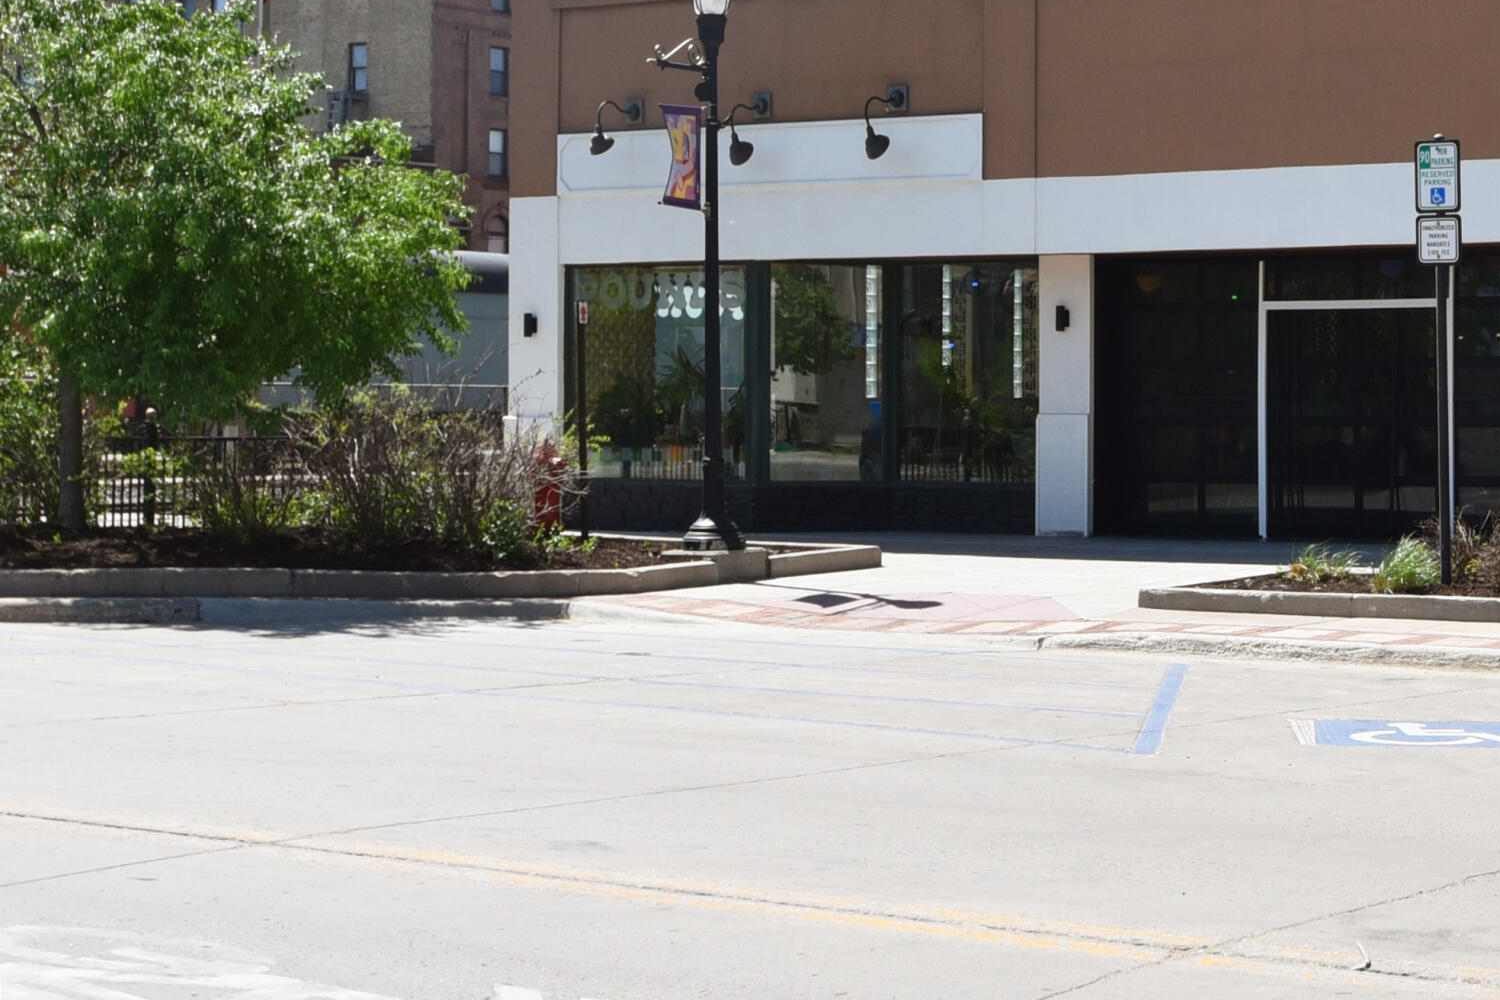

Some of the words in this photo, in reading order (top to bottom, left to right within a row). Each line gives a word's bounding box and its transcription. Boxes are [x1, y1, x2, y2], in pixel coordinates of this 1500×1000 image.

[1420, 151, 1430, 164] 90
[1431, 157, 1454, 166] PARKING
[1421, 170, 1455, 178] RESERVED
